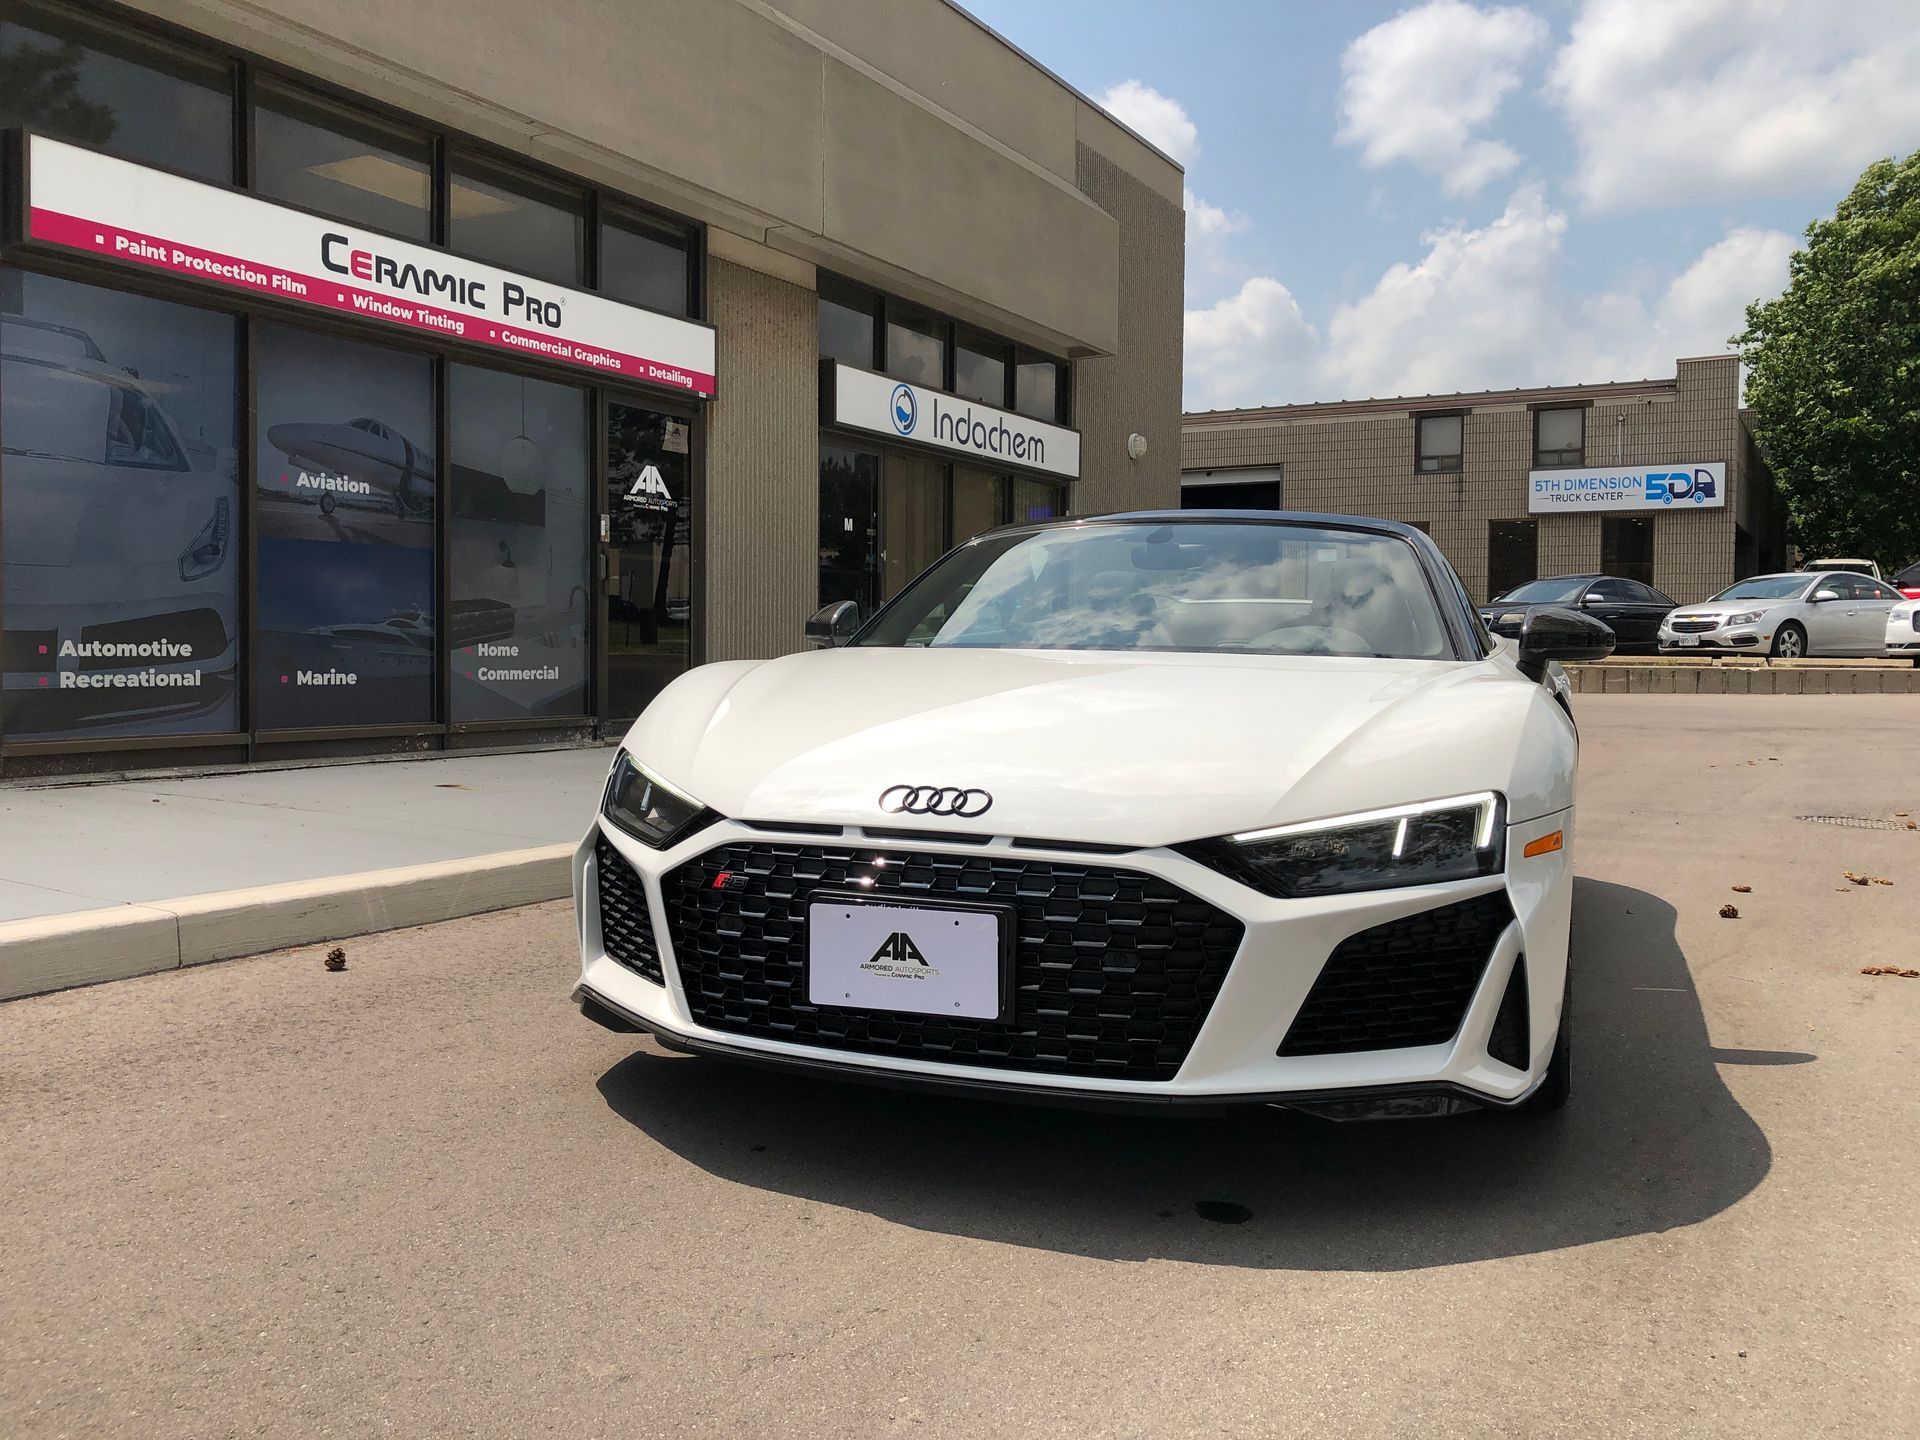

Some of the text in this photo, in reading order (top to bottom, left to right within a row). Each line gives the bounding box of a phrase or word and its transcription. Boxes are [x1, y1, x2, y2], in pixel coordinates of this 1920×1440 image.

[116, 235, 307, 297] Paint Protection Film
[352, 293, 465, 335] Window Tinting
[501, 330, 622, 370] Commercial Graphics
[648, 365, 693, 388] Detailing
[933, 398, 1044, 463] Indachem
[296, 472, 370, 495] Aviation
[1534, 476, 1642, 492] 5TH DIMENSION
[1549, 491, 1624, 503] TRUCK CENTER
[59, 638, 192, 657] Automotive
[477, 642, 519, 657] Home
[59, 669, 201, 688] Recreational
[296, 669, 357, 686] Marine
[477, 665, 559, 681] Commercial
[860, 963, 940, 976] ARMORED AUTOSPORTS
